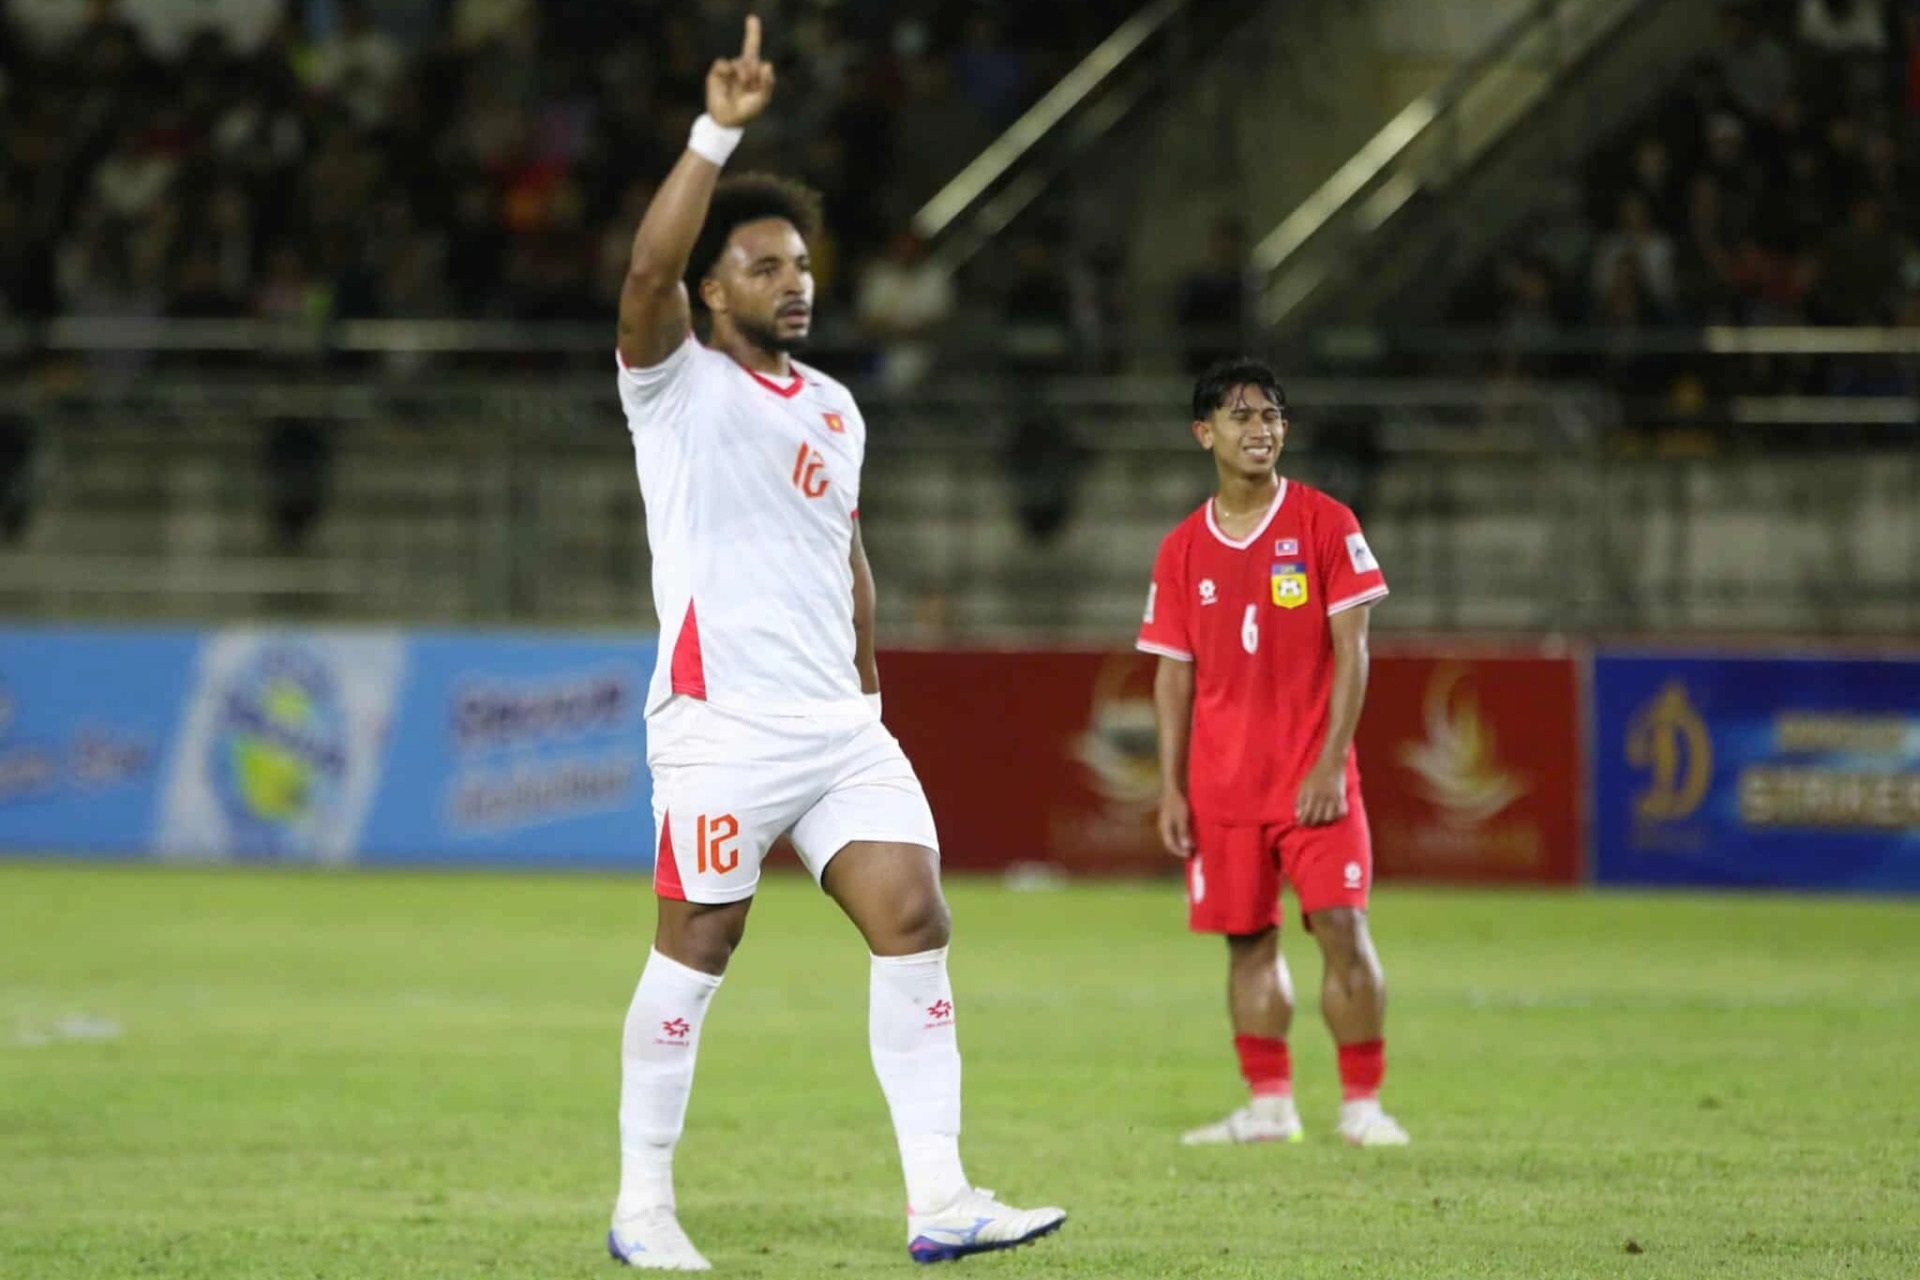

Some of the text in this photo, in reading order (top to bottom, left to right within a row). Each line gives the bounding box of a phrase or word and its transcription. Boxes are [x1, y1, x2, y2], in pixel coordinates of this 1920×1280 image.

[792, 441, 830, 498] 12
[1241, 604, 1260, 655] 6
[697, 812, 740, 875] 12
